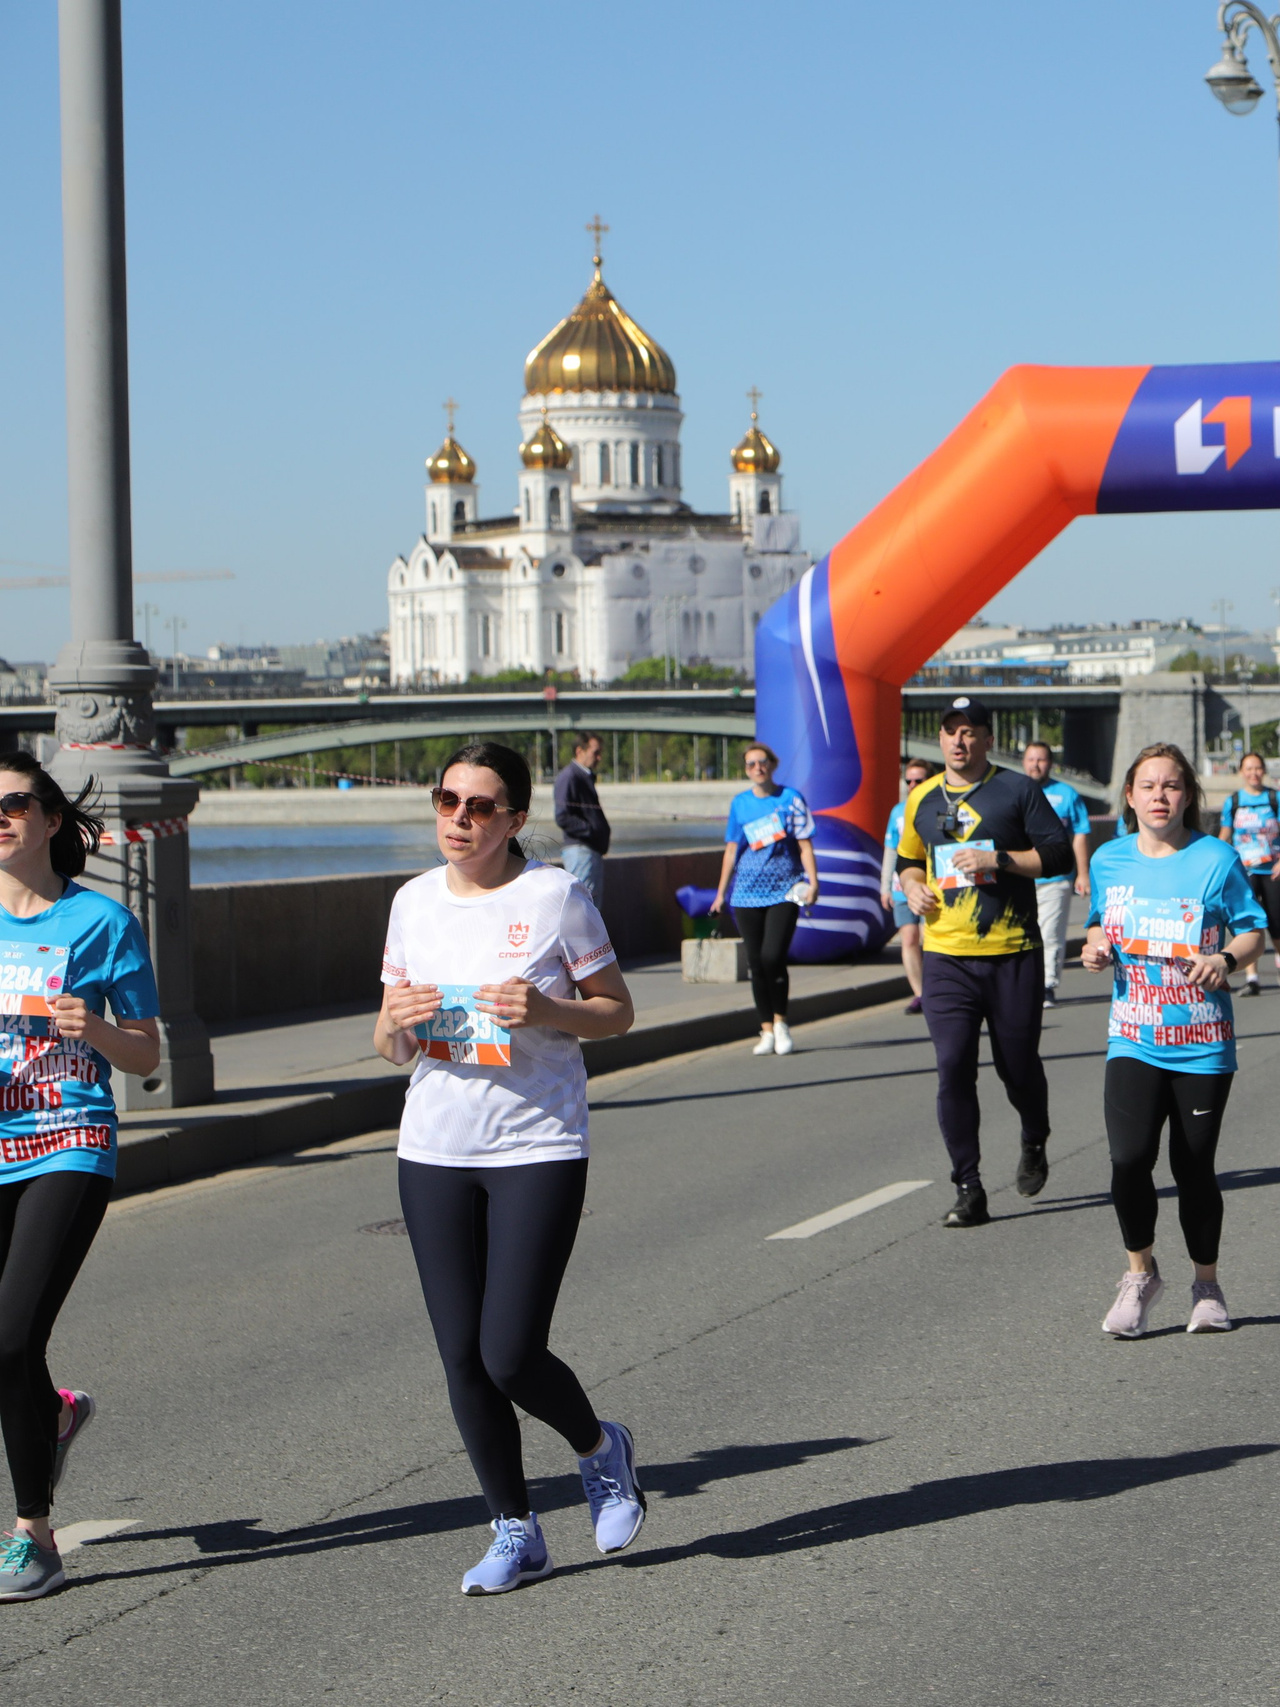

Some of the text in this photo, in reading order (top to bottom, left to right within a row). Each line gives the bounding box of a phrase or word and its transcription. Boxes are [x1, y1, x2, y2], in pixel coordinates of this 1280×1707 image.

[1137, 916, 1186, 941] 21989
[0, 964, 43, 992] 284
[432, 1010, 491, 1040] 23283
[1189, 1003, 1222, 1023] 2024
[1153, 1021, 1232, 1046] #ЕДИНСТВО
[36, 1108, 89, 1133] 2024
[0, 1124, 111, 1163] ЕДИНСТВО
